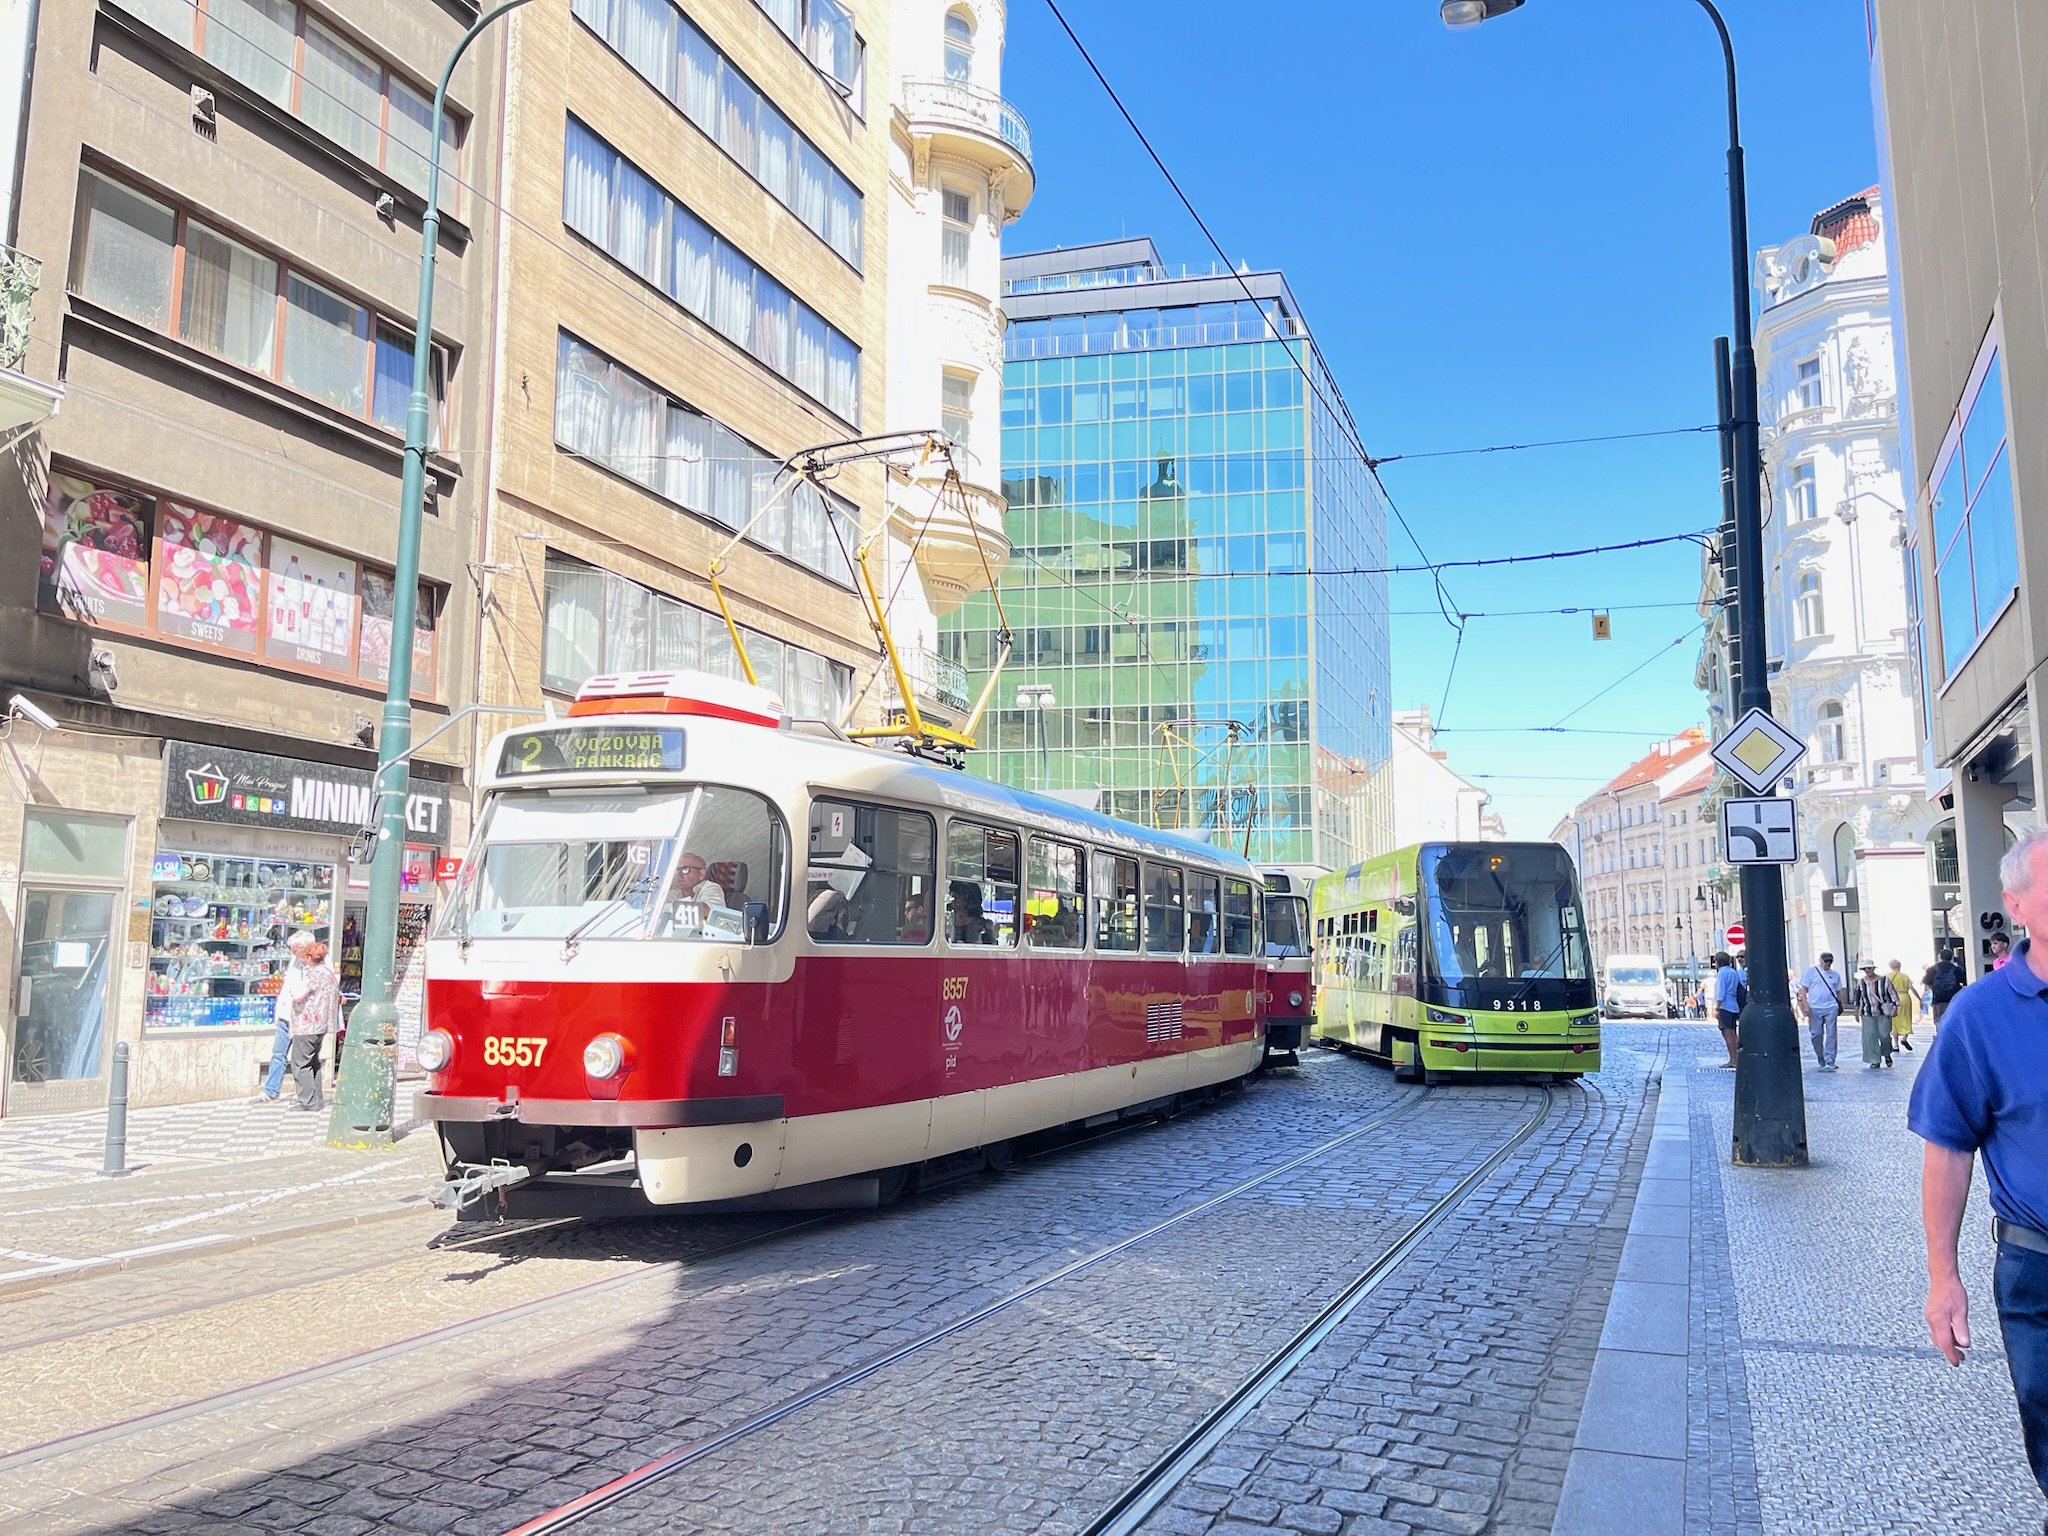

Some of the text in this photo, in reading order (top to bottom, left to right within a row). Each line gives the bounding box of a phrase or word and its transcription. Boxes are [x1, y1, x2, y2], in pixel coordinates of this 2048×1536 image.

[190, 621, 224, 642] SWEETS
[296, 647, 322, 665] DRINKS
[521, 734, 663, 772] 2 VOZOVNA
[290, 777, 443, 833] MINIMKET
[163, 861, 179, 873] SIM
[675, 904, 700, 926] 411
[942, 976, 969, 1001] 8557
[1492, 999, 1542, 1011] 9318
[483, 1035, 548, 1067] 8557
[945, 1054, 957, 1071] pid
